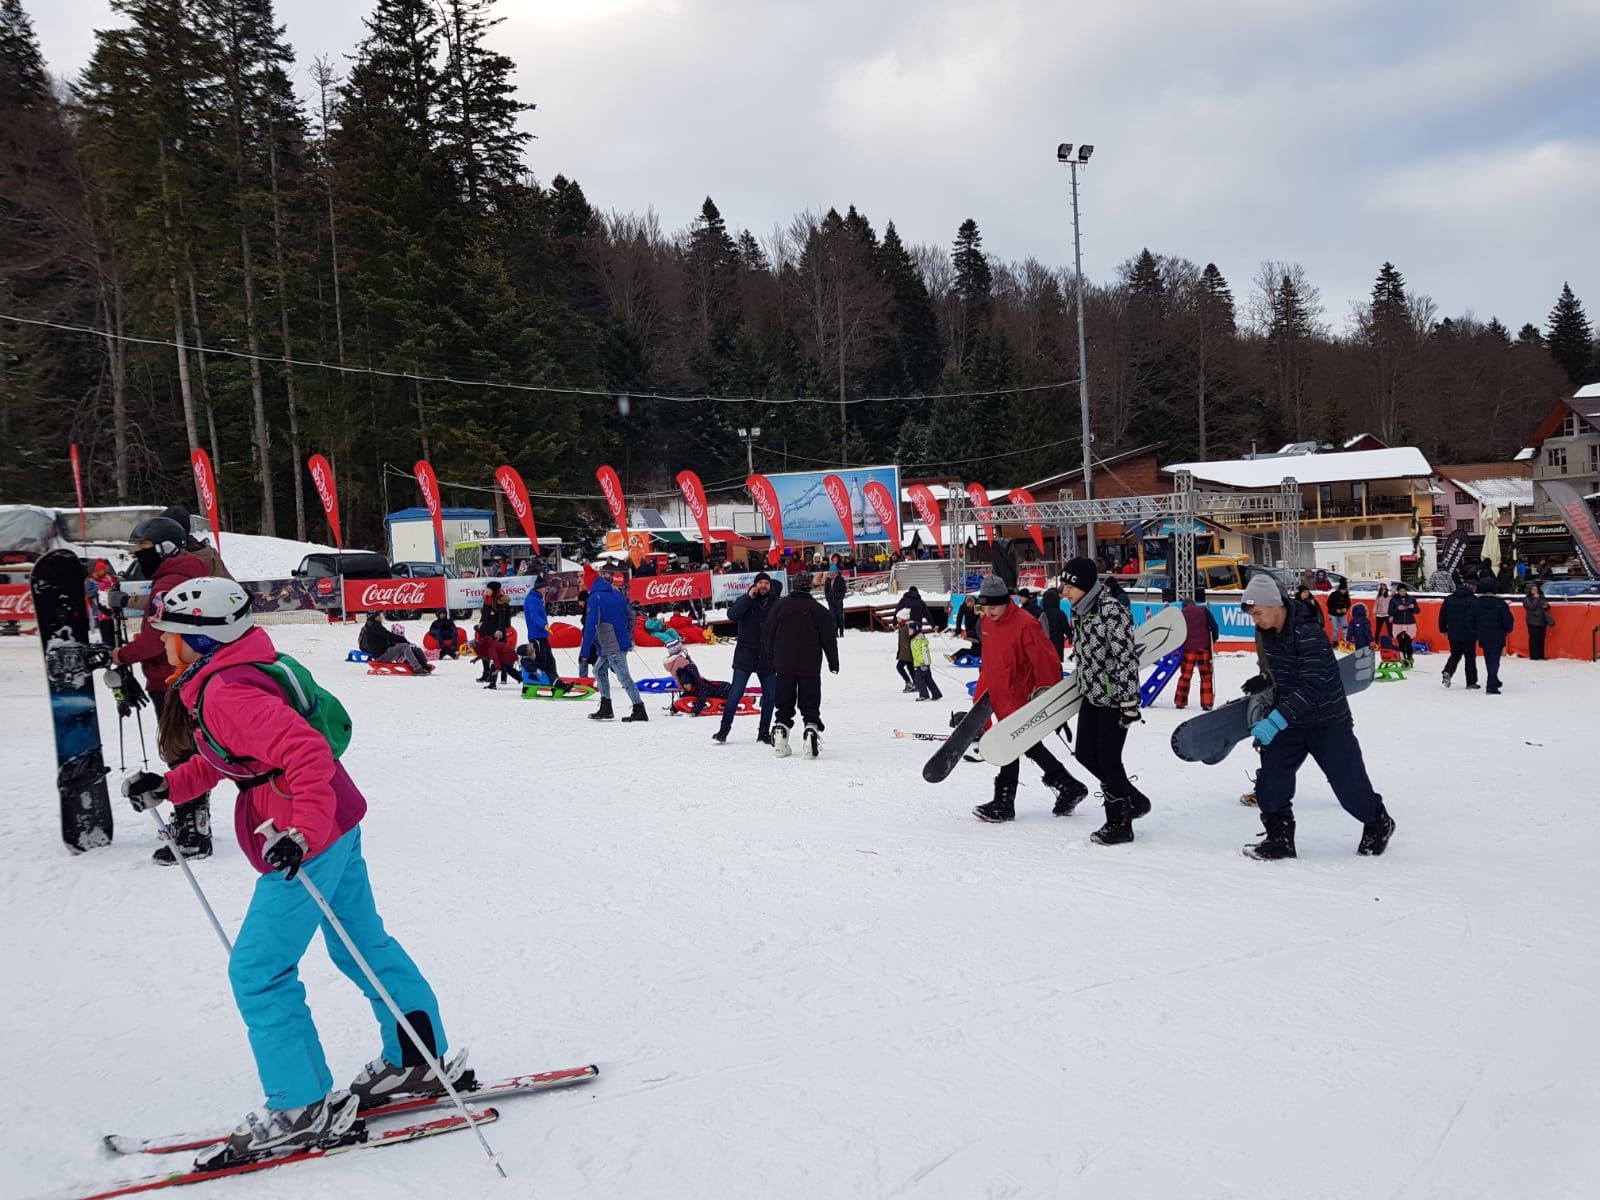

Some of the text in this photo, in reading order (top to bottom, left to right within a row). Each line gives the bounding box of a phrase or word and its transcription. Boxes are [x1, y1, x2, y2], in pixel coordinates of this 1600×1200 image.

[1525, 525, 1567, 534] Minunate
[362, 582, 428, 606] Coca-Cola
[646, 577, 694, 600] Coca-Cola
